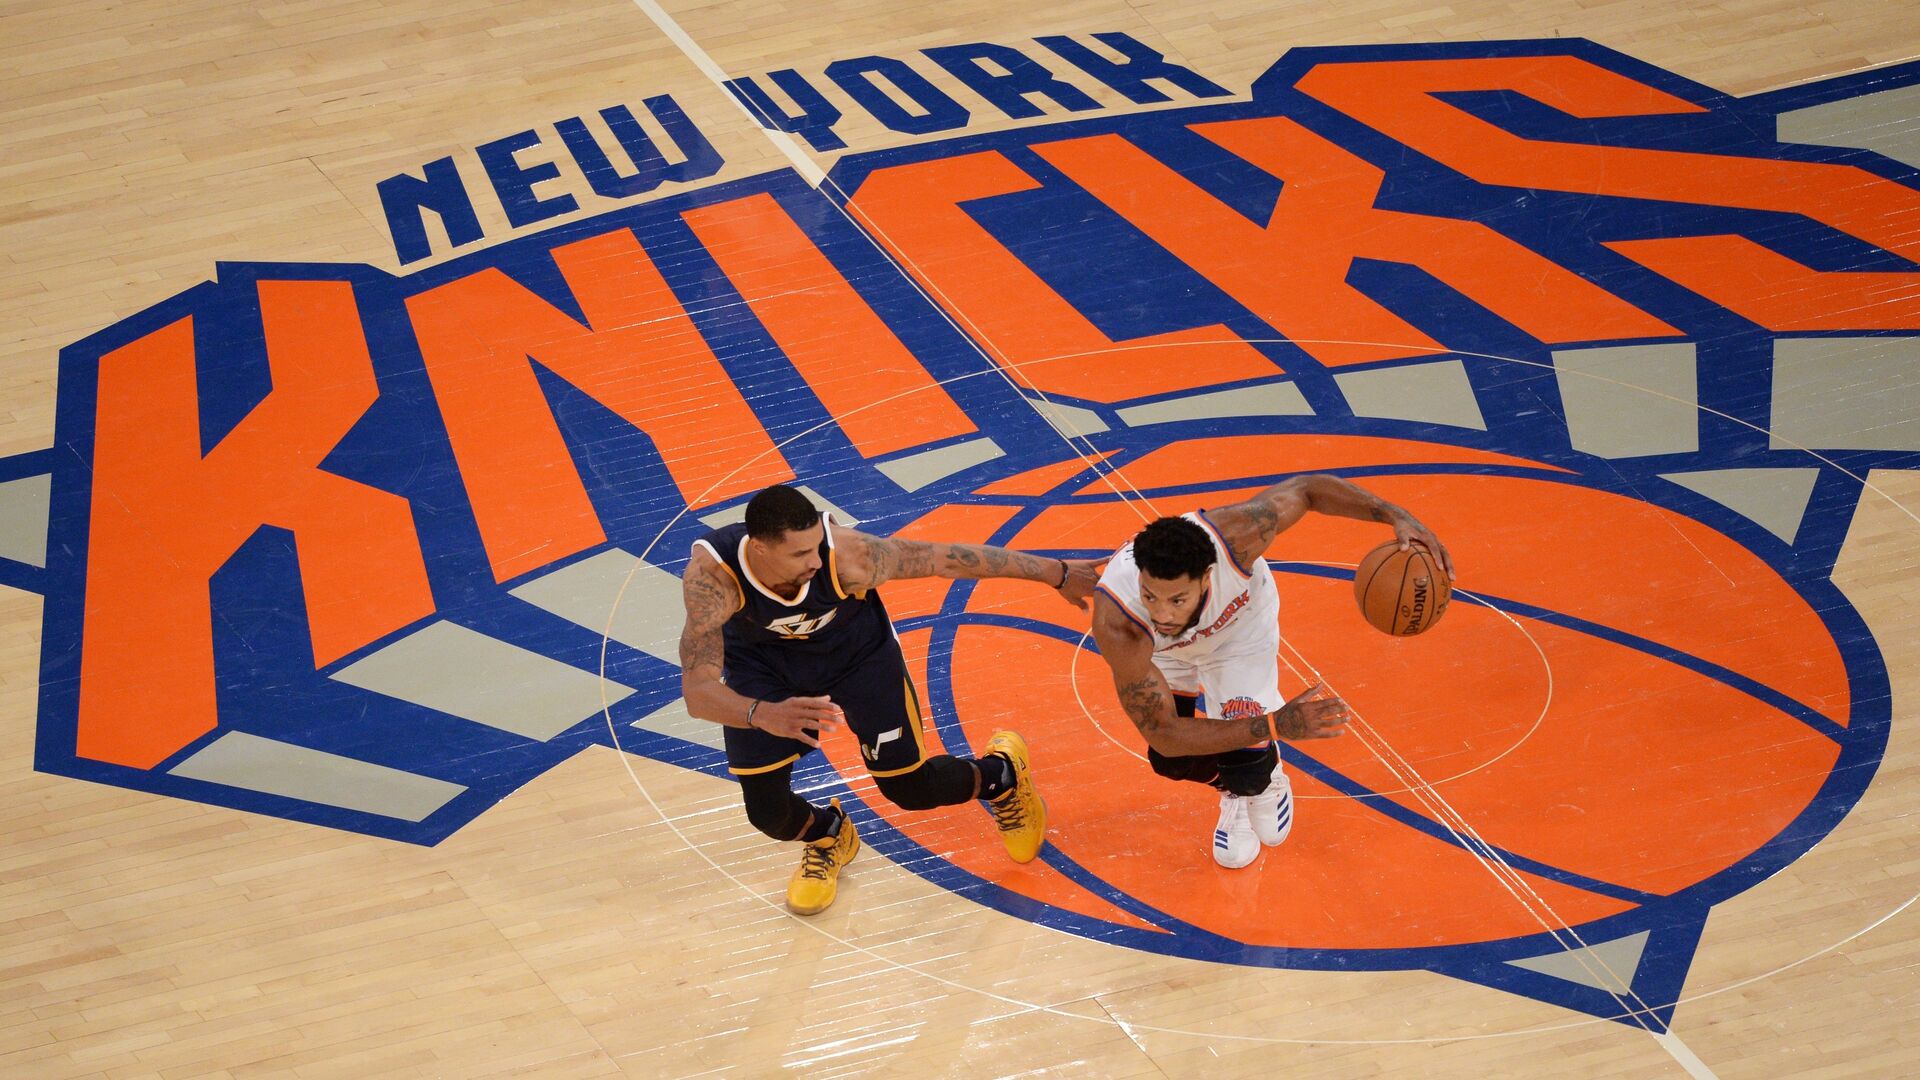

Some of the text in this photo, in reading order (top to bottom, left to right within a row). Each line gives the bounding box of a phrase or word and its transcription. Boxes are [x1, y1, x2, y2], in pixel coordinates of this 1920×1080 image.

[376, 32, 1236, 266] NEW YORK
[76, 55, 1920, 771] KNICKS
[1222, 699, 1264, 717] KNICKS
